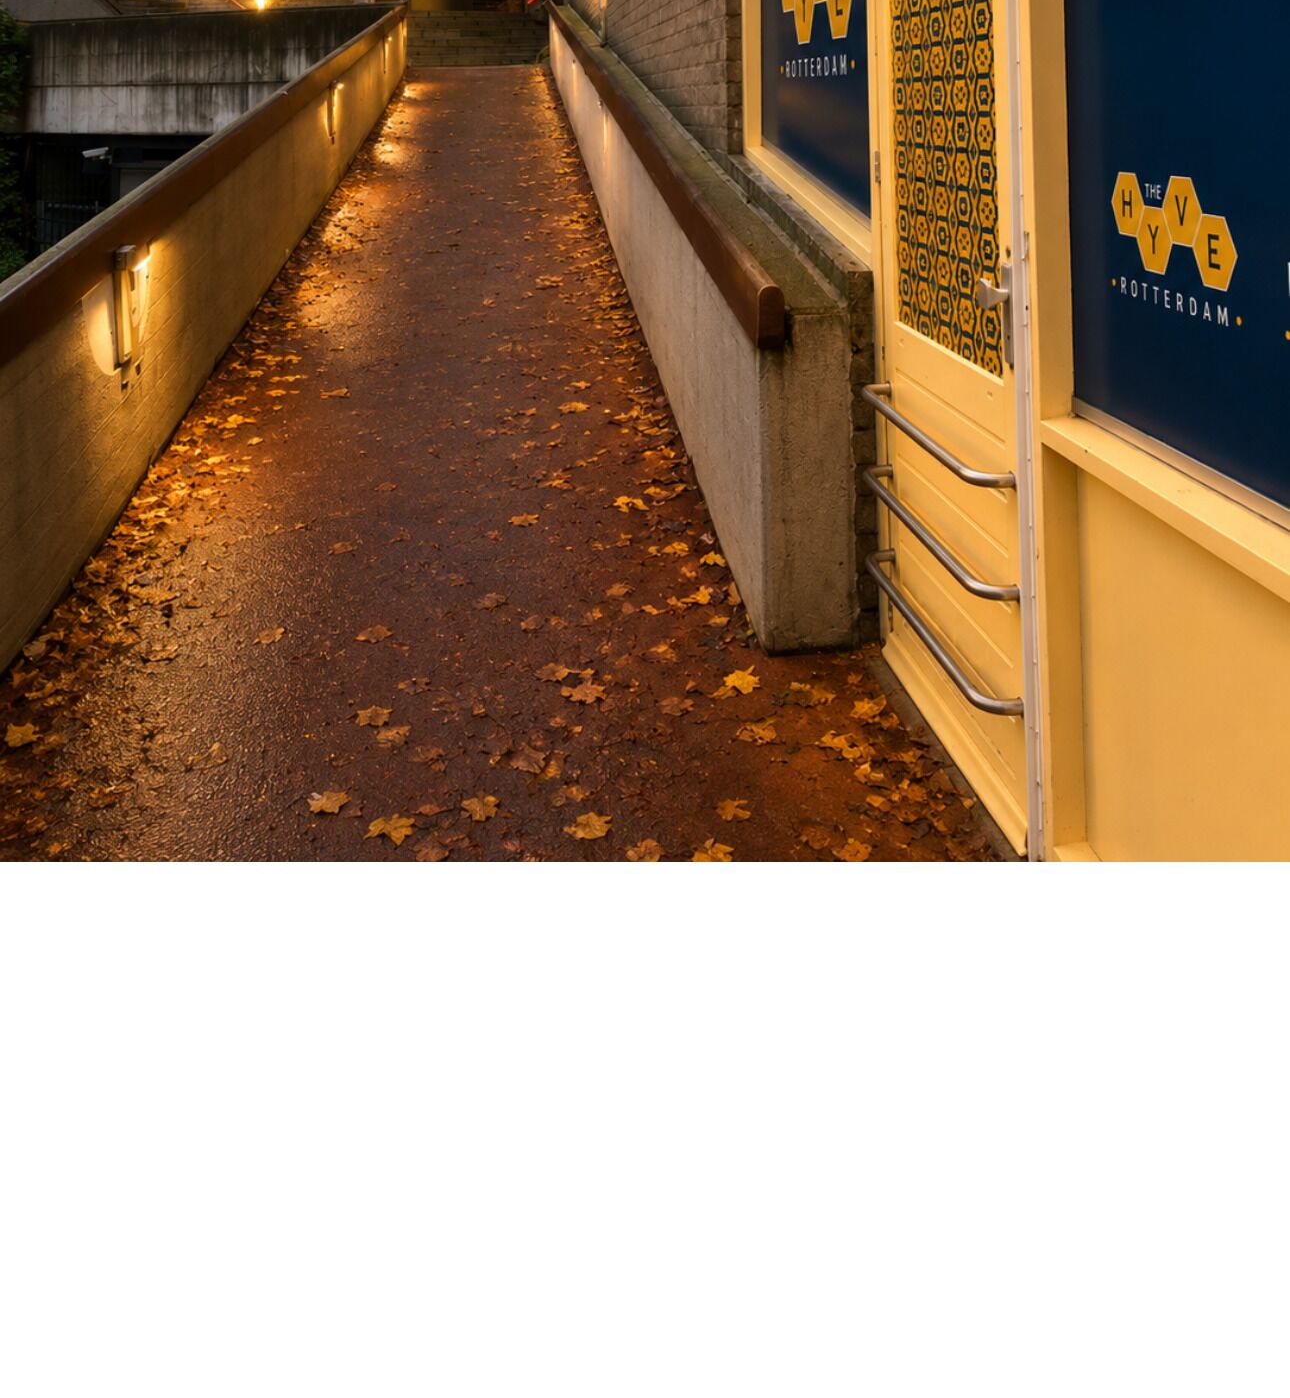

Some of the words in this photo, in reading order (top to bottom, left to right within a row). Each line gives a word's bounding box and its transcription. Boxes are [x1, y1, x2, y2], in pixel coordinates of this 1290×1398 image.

[785, 54, 848, 78] ROTTERDAM
[1144, 183, 1162, 200] THE
[1121, 188, 1221, 271] HYVE
[1120, 276, 1229, 327] ROTTERDAM
